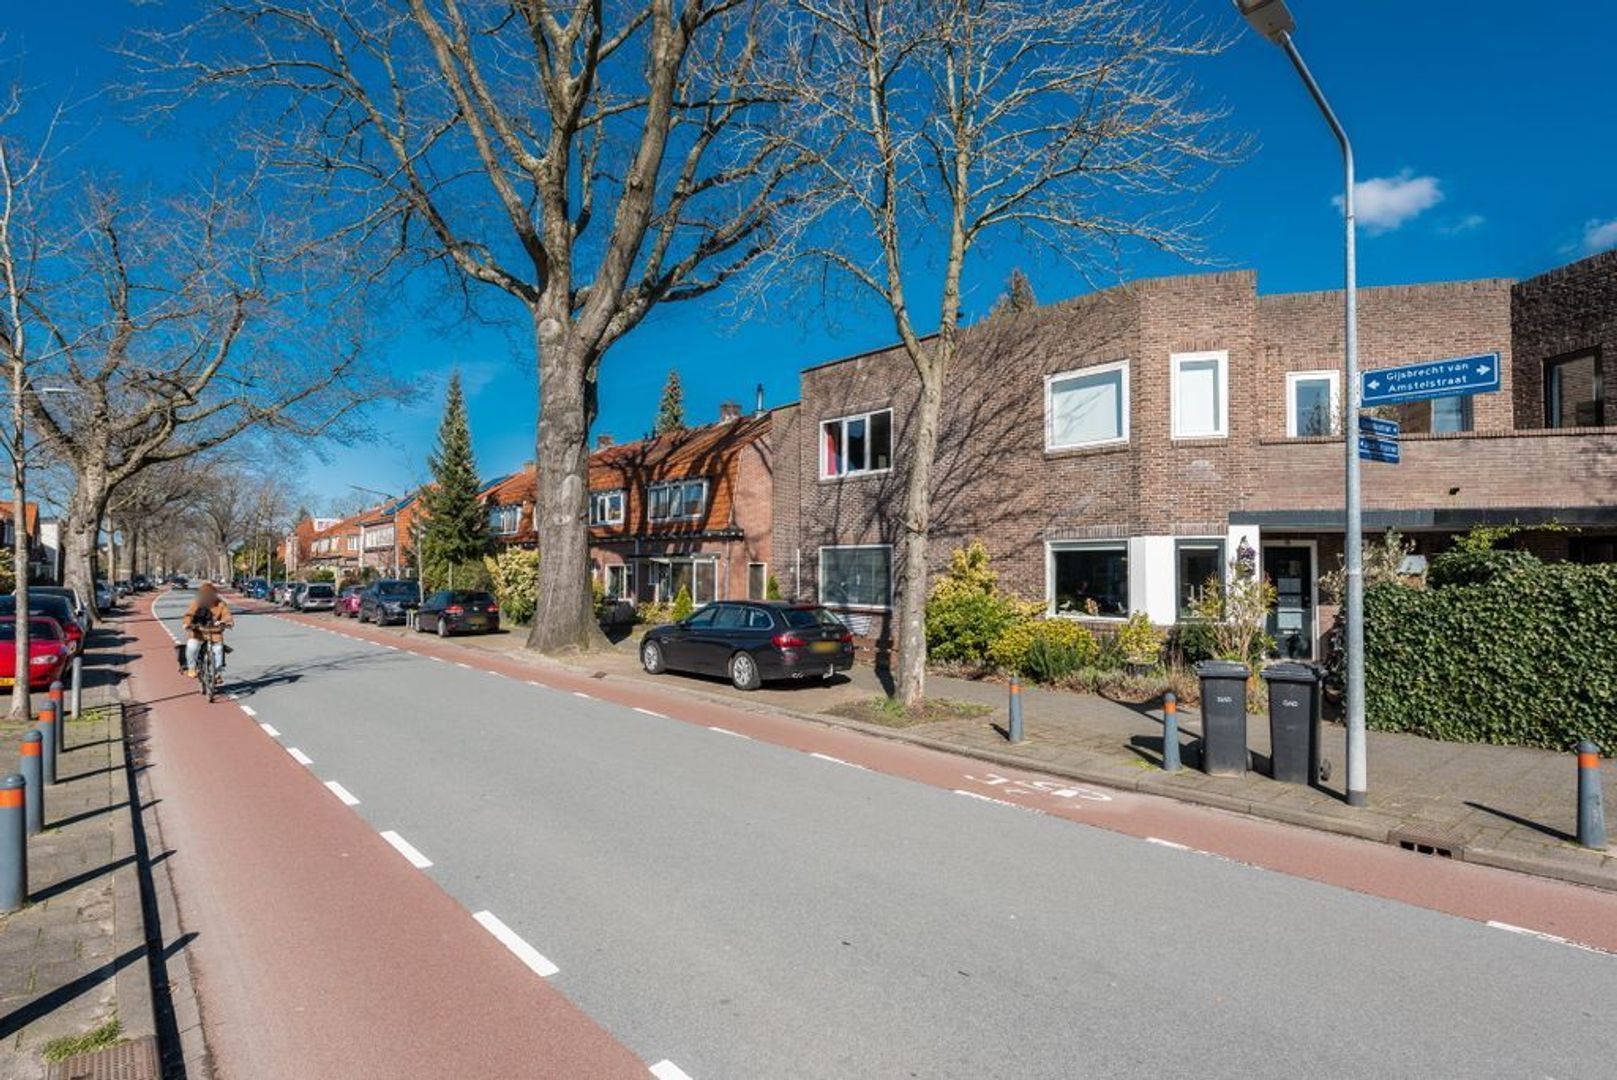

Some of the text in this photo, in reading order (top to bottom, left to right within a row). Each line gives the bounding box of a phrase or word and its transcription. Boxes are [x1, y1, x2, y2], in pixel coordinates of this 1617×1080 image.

[1386, 363, 1469, 381] Gijsbrecht van
[1388, 375, 1467, 393] Amstelstraat
